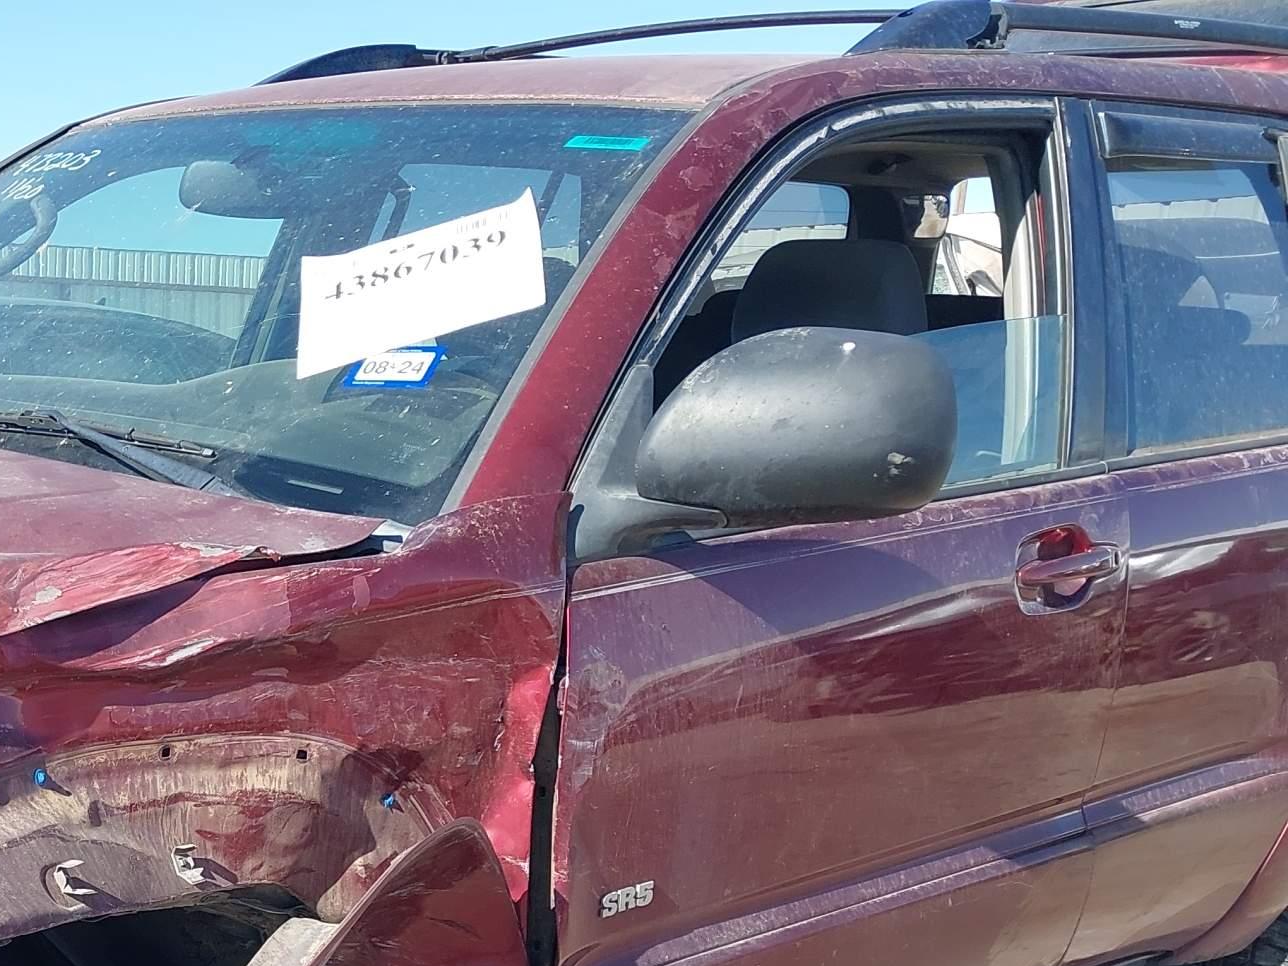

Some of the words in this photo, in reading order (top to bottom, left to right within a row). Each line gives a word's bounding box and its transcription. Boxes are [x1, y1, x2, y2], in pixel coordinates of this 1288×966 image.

[324, 230, 507, 300] 43867039
[363, 360, 390, 375] 08
[397, 360, 425, 375] 24
[600, 880, 655, 919] SR5
